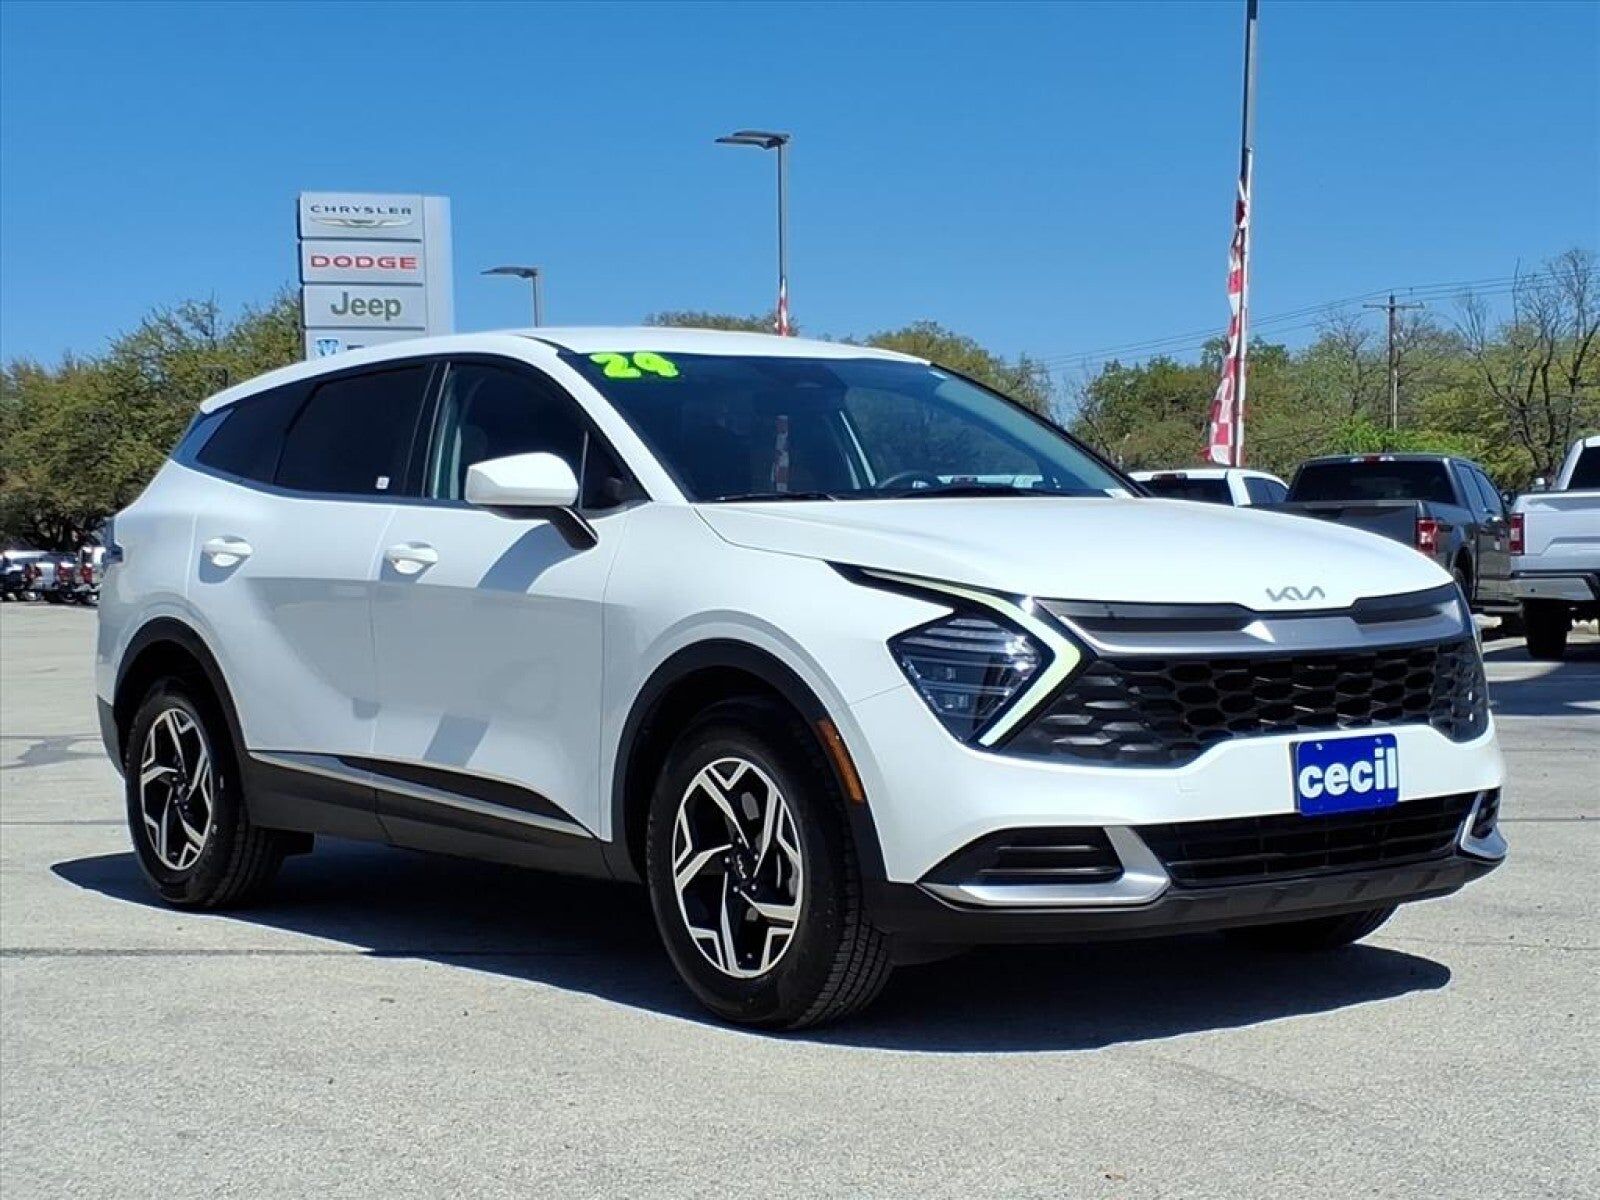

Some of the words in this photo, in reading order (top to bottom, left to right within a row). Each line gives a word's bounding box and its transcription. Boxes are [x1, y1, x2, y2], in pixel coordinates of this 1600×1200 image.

[310, 205, 412, 215] CHRYSLER
[311, 255, 417, 270] DODGE
[330, 291, 402, 321] Jeep
[1299, 747, 1398, 799] cecil
